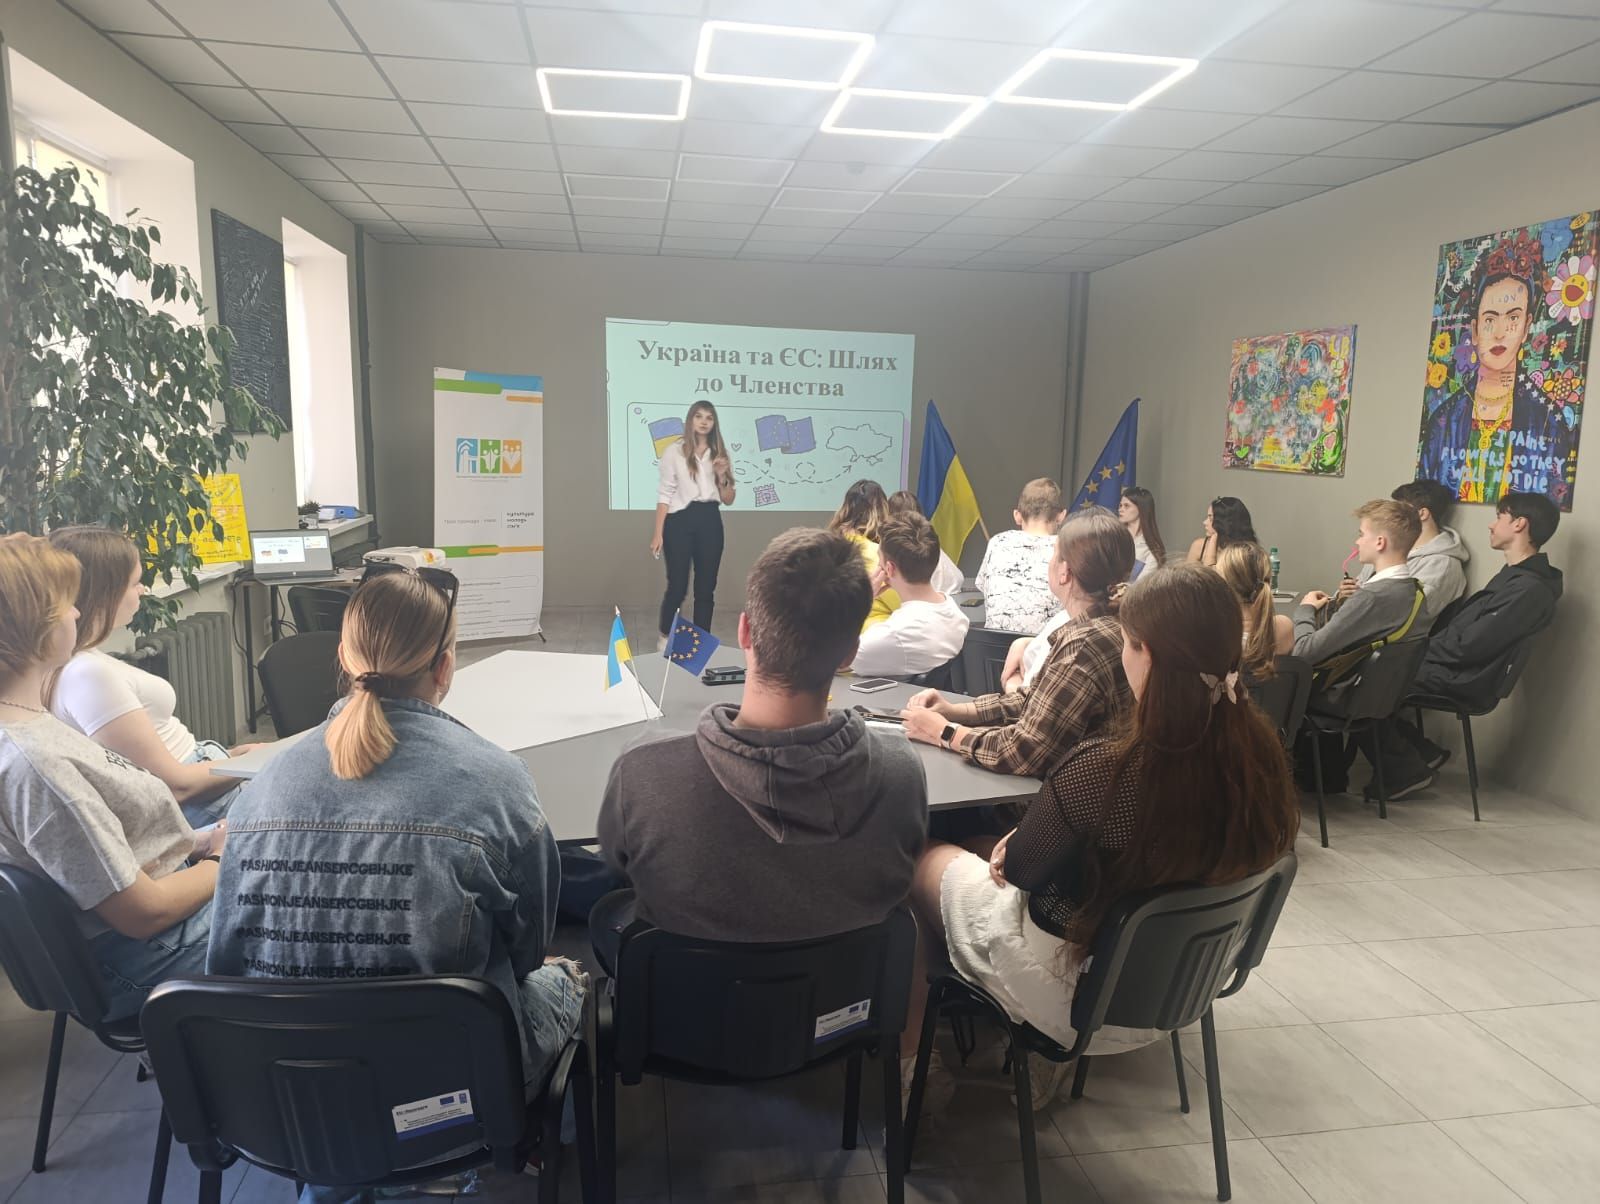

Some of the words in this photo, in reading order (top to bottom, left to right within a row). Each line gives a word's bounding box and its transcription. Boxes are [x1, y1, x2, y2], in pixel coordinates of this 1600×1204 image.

[637, 339, 741, 367] Україна
[746, 350, 773, 366] та
[779, 347, 823, 369] ЄС:
[828, 349, 898, 372] Шлях
[694, 375, 723, 394] до
[729, 374, 845, 397] Членства
[240, 859, 415, 876] FASHIONJEANSERCGBHJKE
[237, 893, 412, 911] FASHIONJEANSERCGBHJKE
